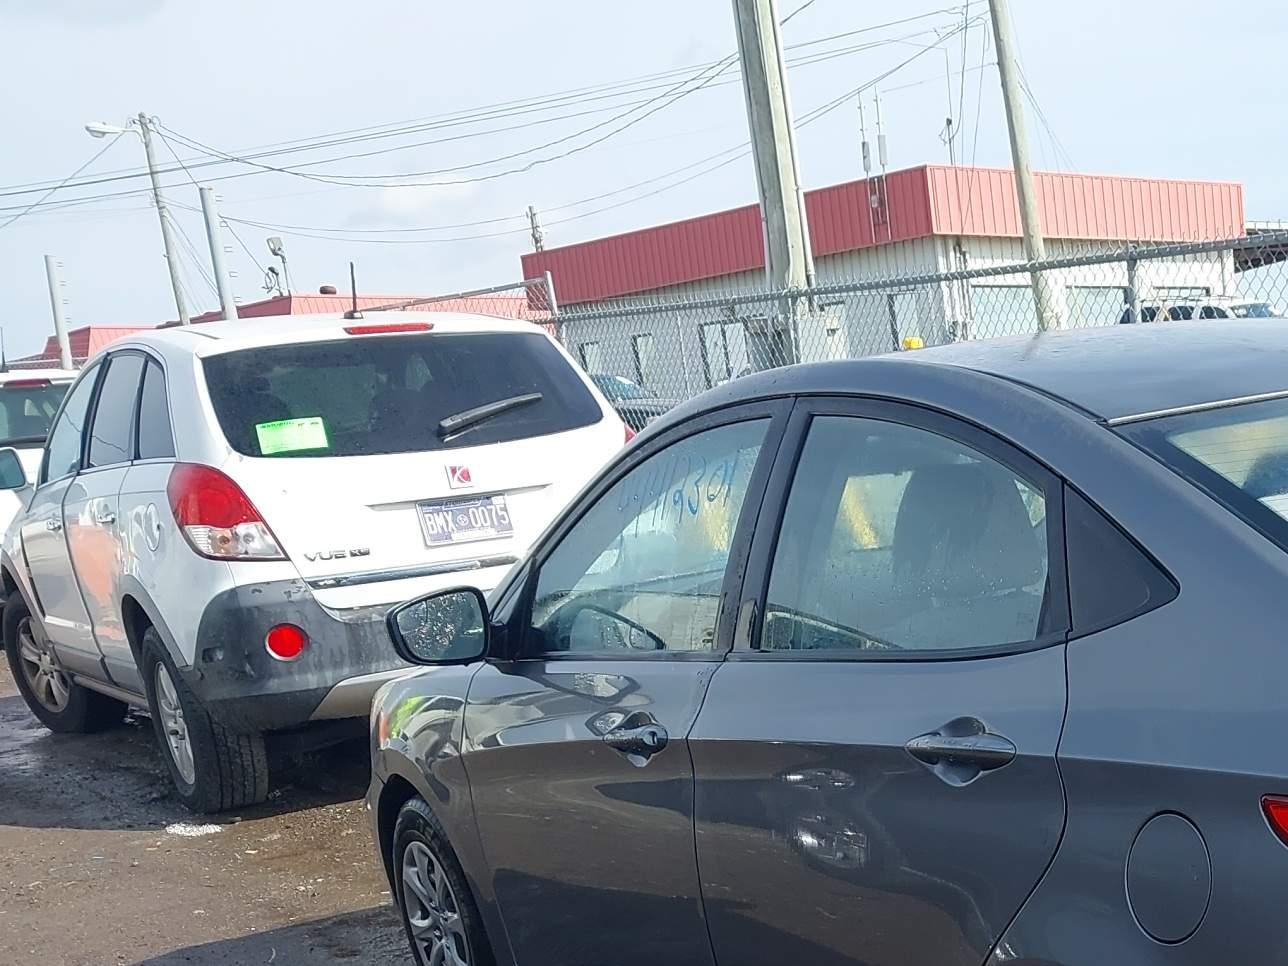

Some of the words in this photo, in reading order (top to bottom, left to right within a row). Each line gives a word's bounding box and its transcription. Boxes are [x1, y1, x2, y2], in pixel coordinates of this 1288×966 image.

[423, 511, 457, 534] BMX
[469, 504, 510, 528] 0075
[304, 550, 347, 562] VUE
